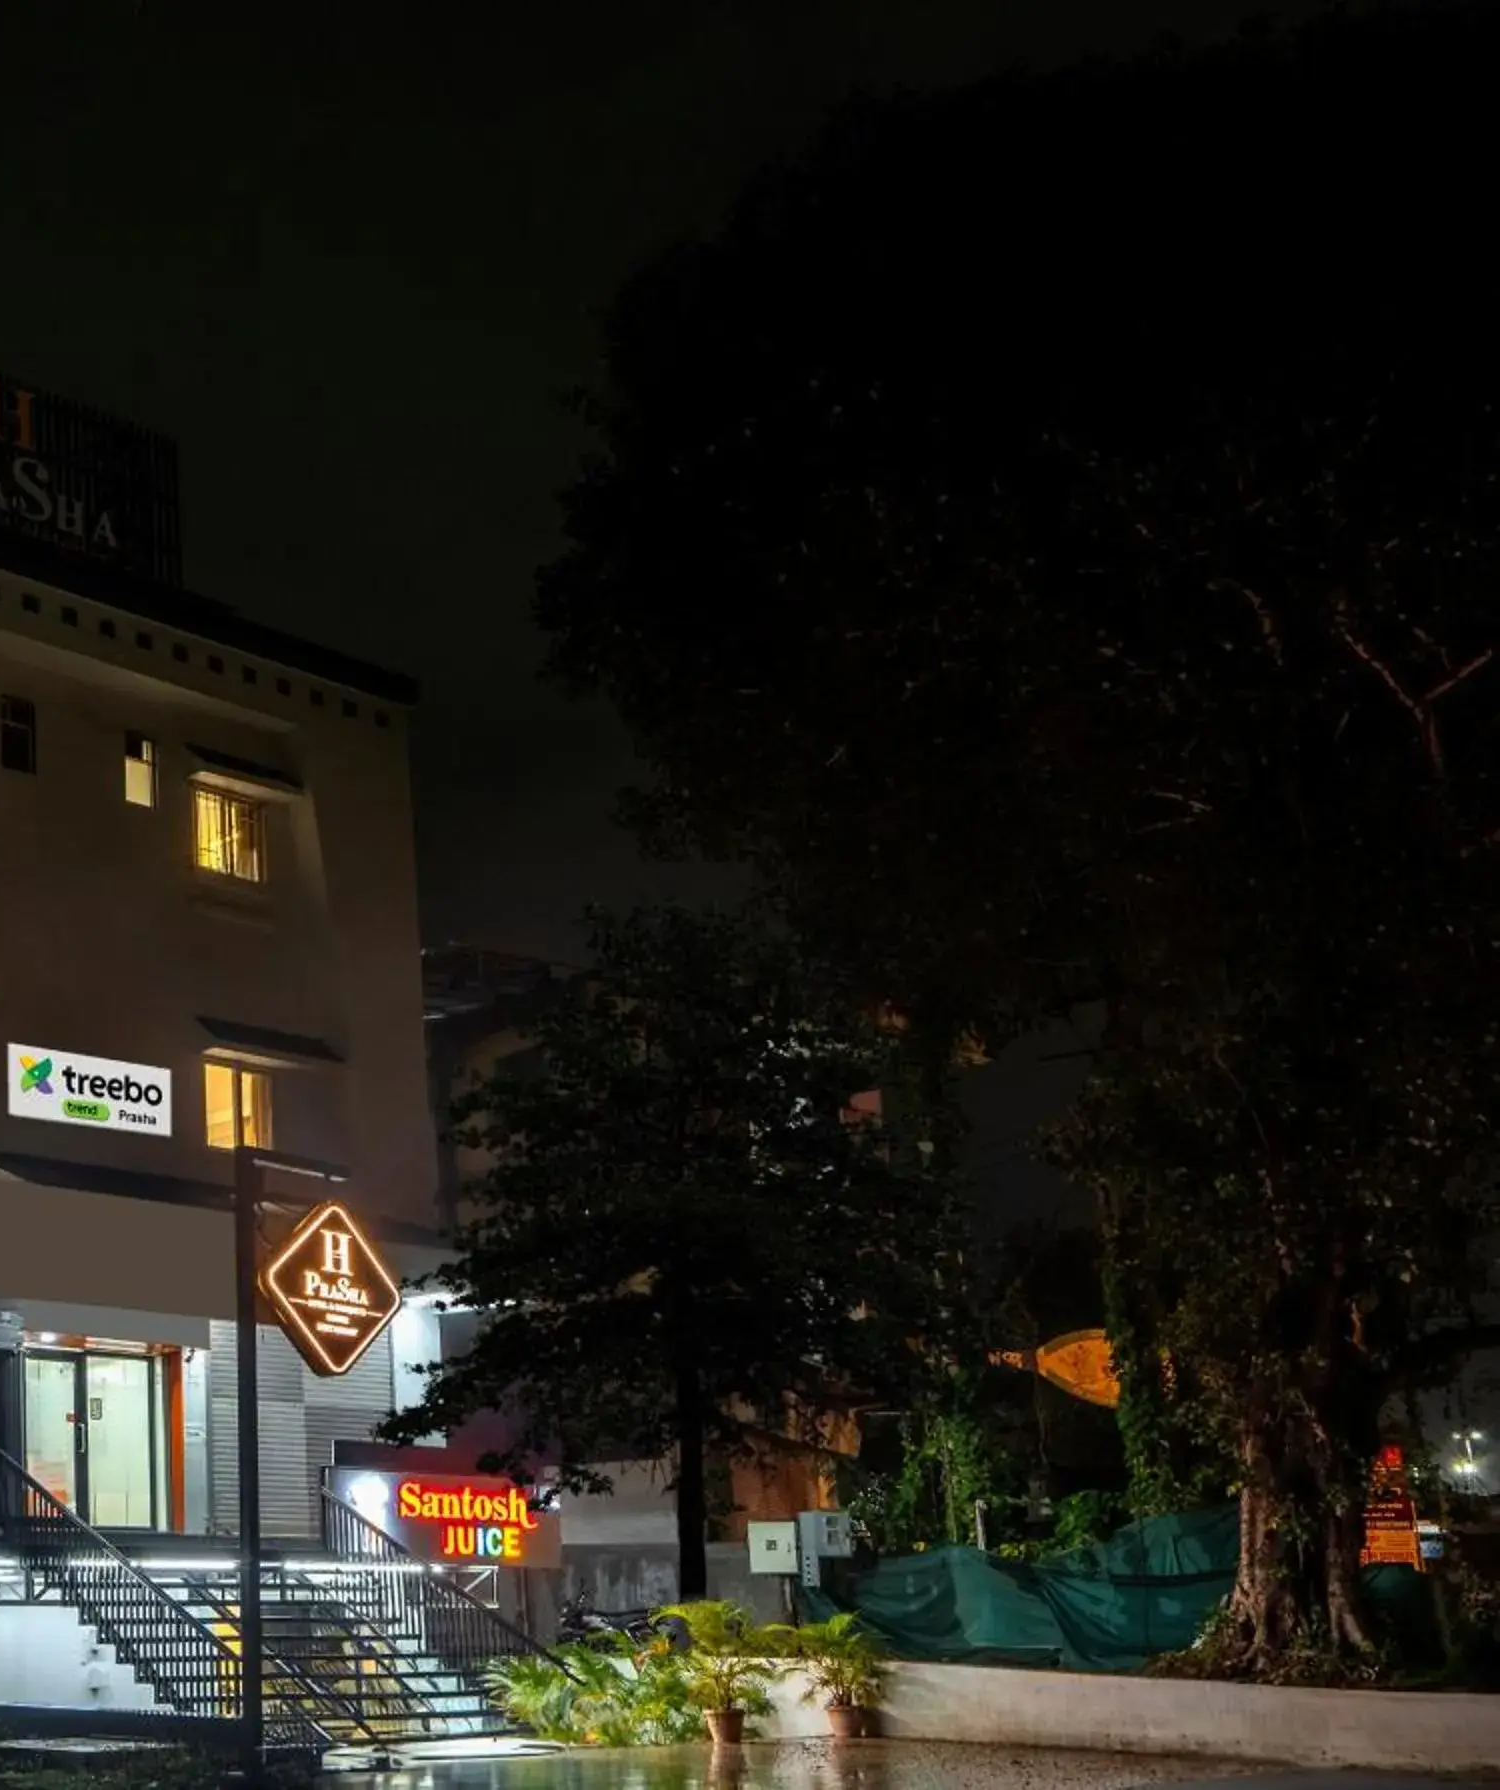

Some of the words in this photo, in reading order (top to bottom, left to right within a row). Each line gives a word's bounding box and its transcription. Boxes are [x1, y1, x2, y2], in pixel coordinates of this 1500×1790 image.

[62, 1065, 163, 1106] treebo
[66, 1101, 99, 1117] trend
[118, 1109, 157, 1126] Prasha
[320, 1229, 353, 1276] H
[399, 1482, 538, 1529] Santosh
[444, 1525, 521, 1556] JUICE
